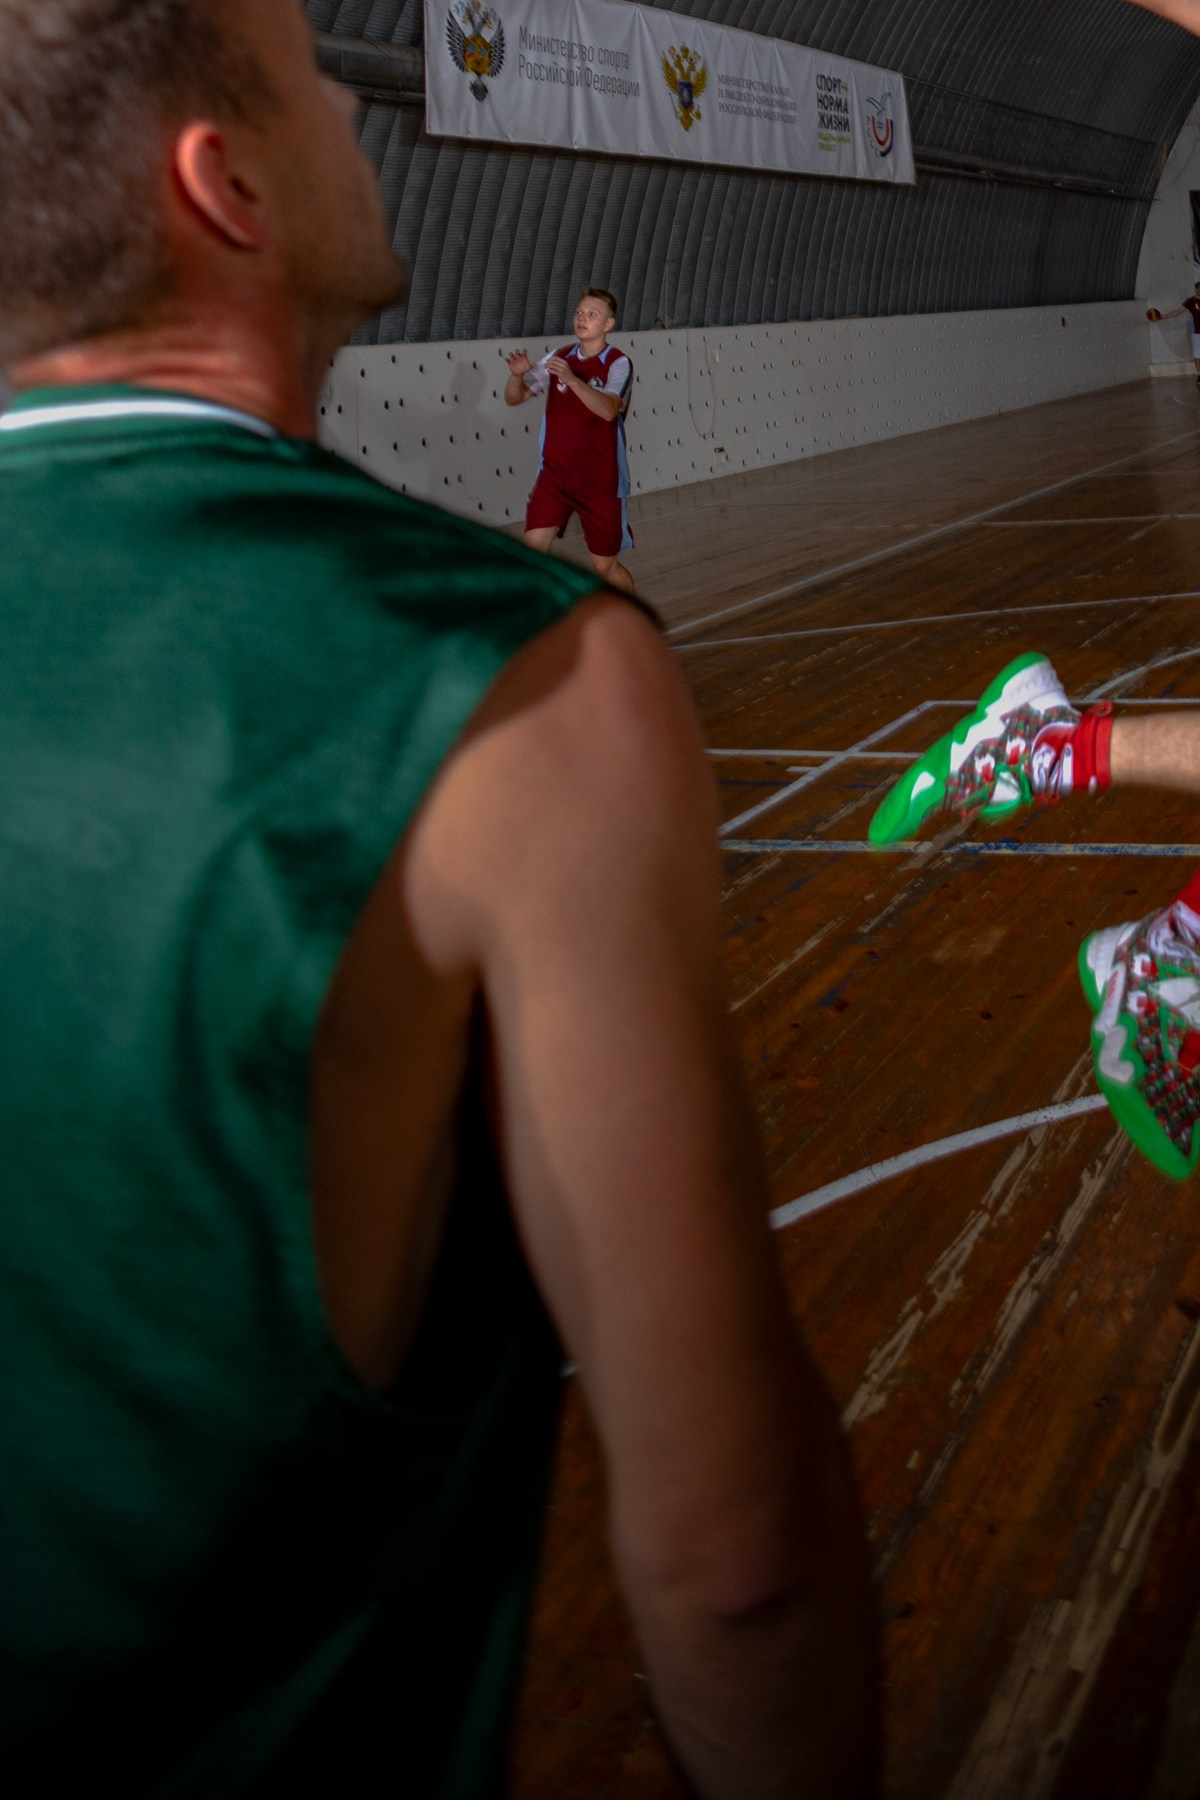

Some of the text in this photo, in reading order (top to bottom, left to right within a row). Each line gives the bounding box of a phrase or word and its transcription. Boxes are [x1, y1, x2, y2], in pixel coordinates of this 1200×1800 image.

[519, 25, 629, 72] Министерство спорта
[519, 54, 640, 98] Российской Федерации
[817, 92, 848, 114] НОРМА
[818, 112, 850, 132] ЖИЗНИ
